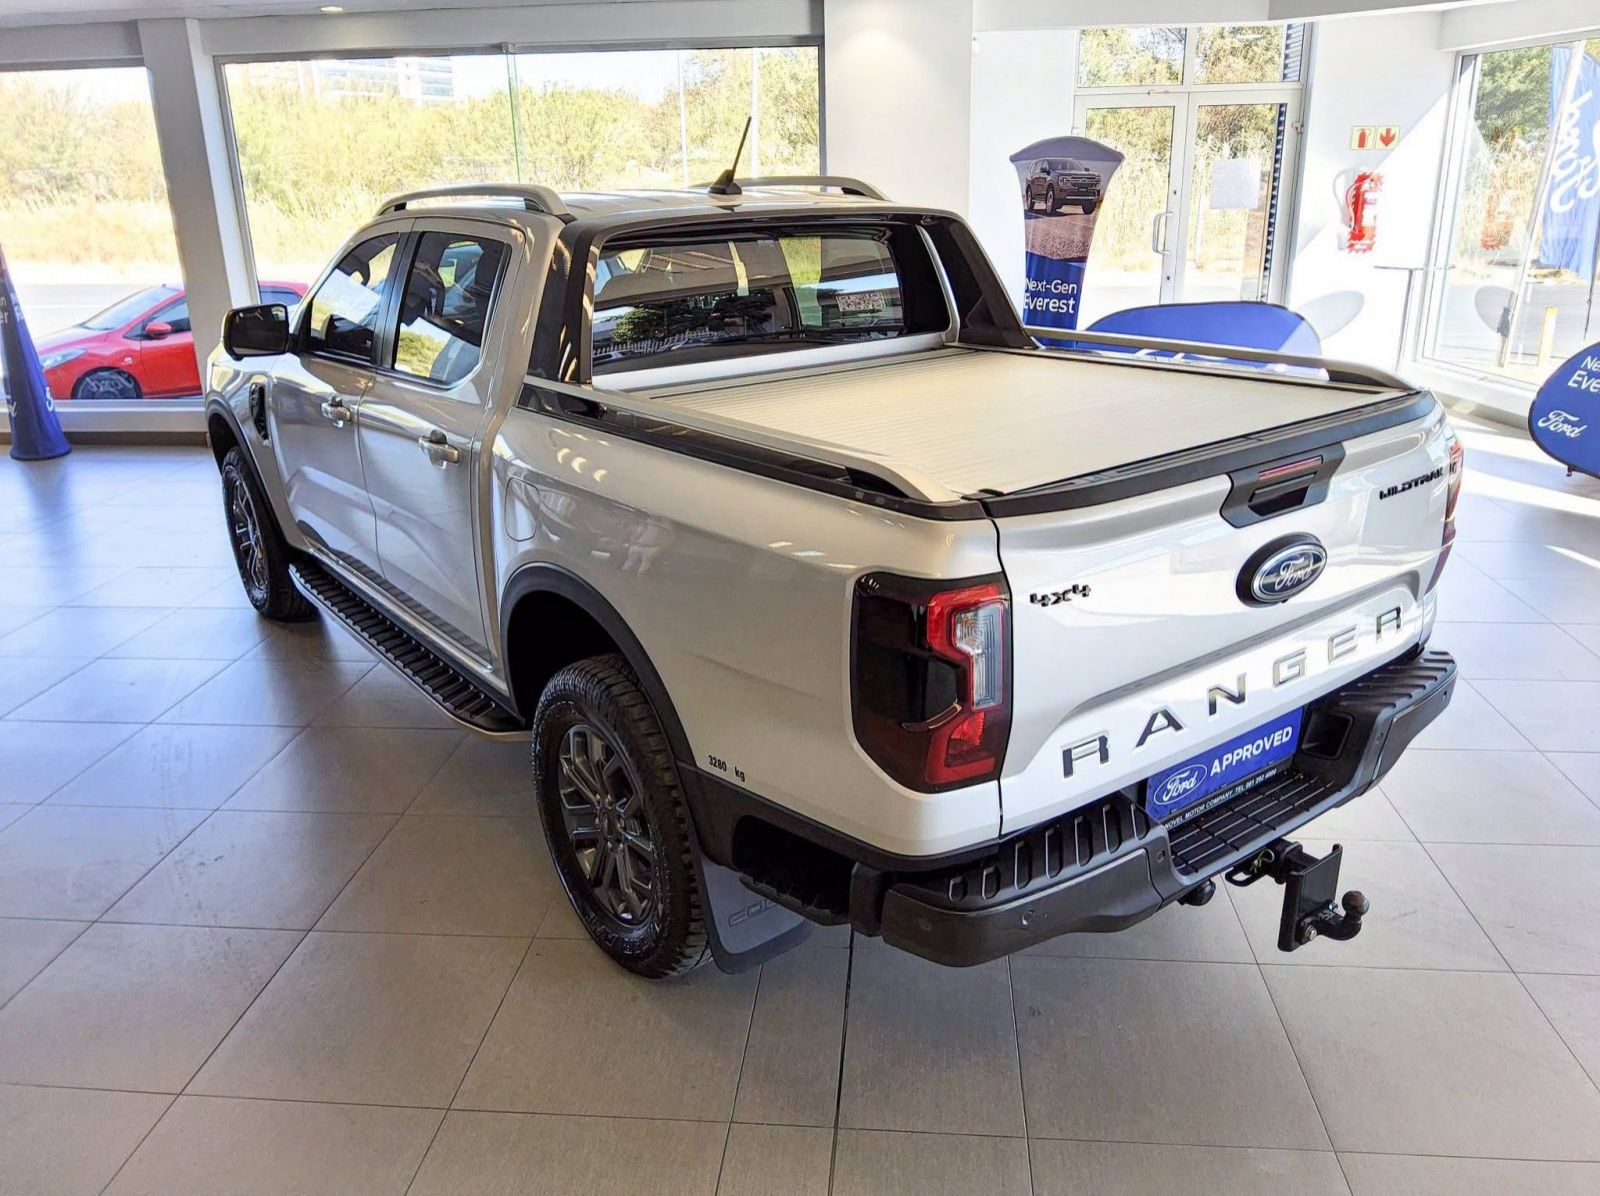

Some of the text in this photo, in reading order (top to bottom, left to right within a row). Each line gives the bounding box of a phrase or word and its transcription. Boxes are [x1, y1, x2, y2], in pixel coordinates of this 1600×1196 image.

[1025, 278, 1077, 294] Next-Gen
[1024, 293, 1075, 314] Everest
[1537, 410, 1588, 438] Ford
[1379, 466, 1443, 500] WILDTRAK
[1274, 552, 1314, 591] Ford
[1062, 606, 1402, 779] RANGER
[708, 754, 746, 782] 3280 kg
[1162, 726, 1293, 802] Ford APPROVED
[1184, 804, 1206, 820] MOTOR
[1205, 790, 1234, 809] COMPANY
